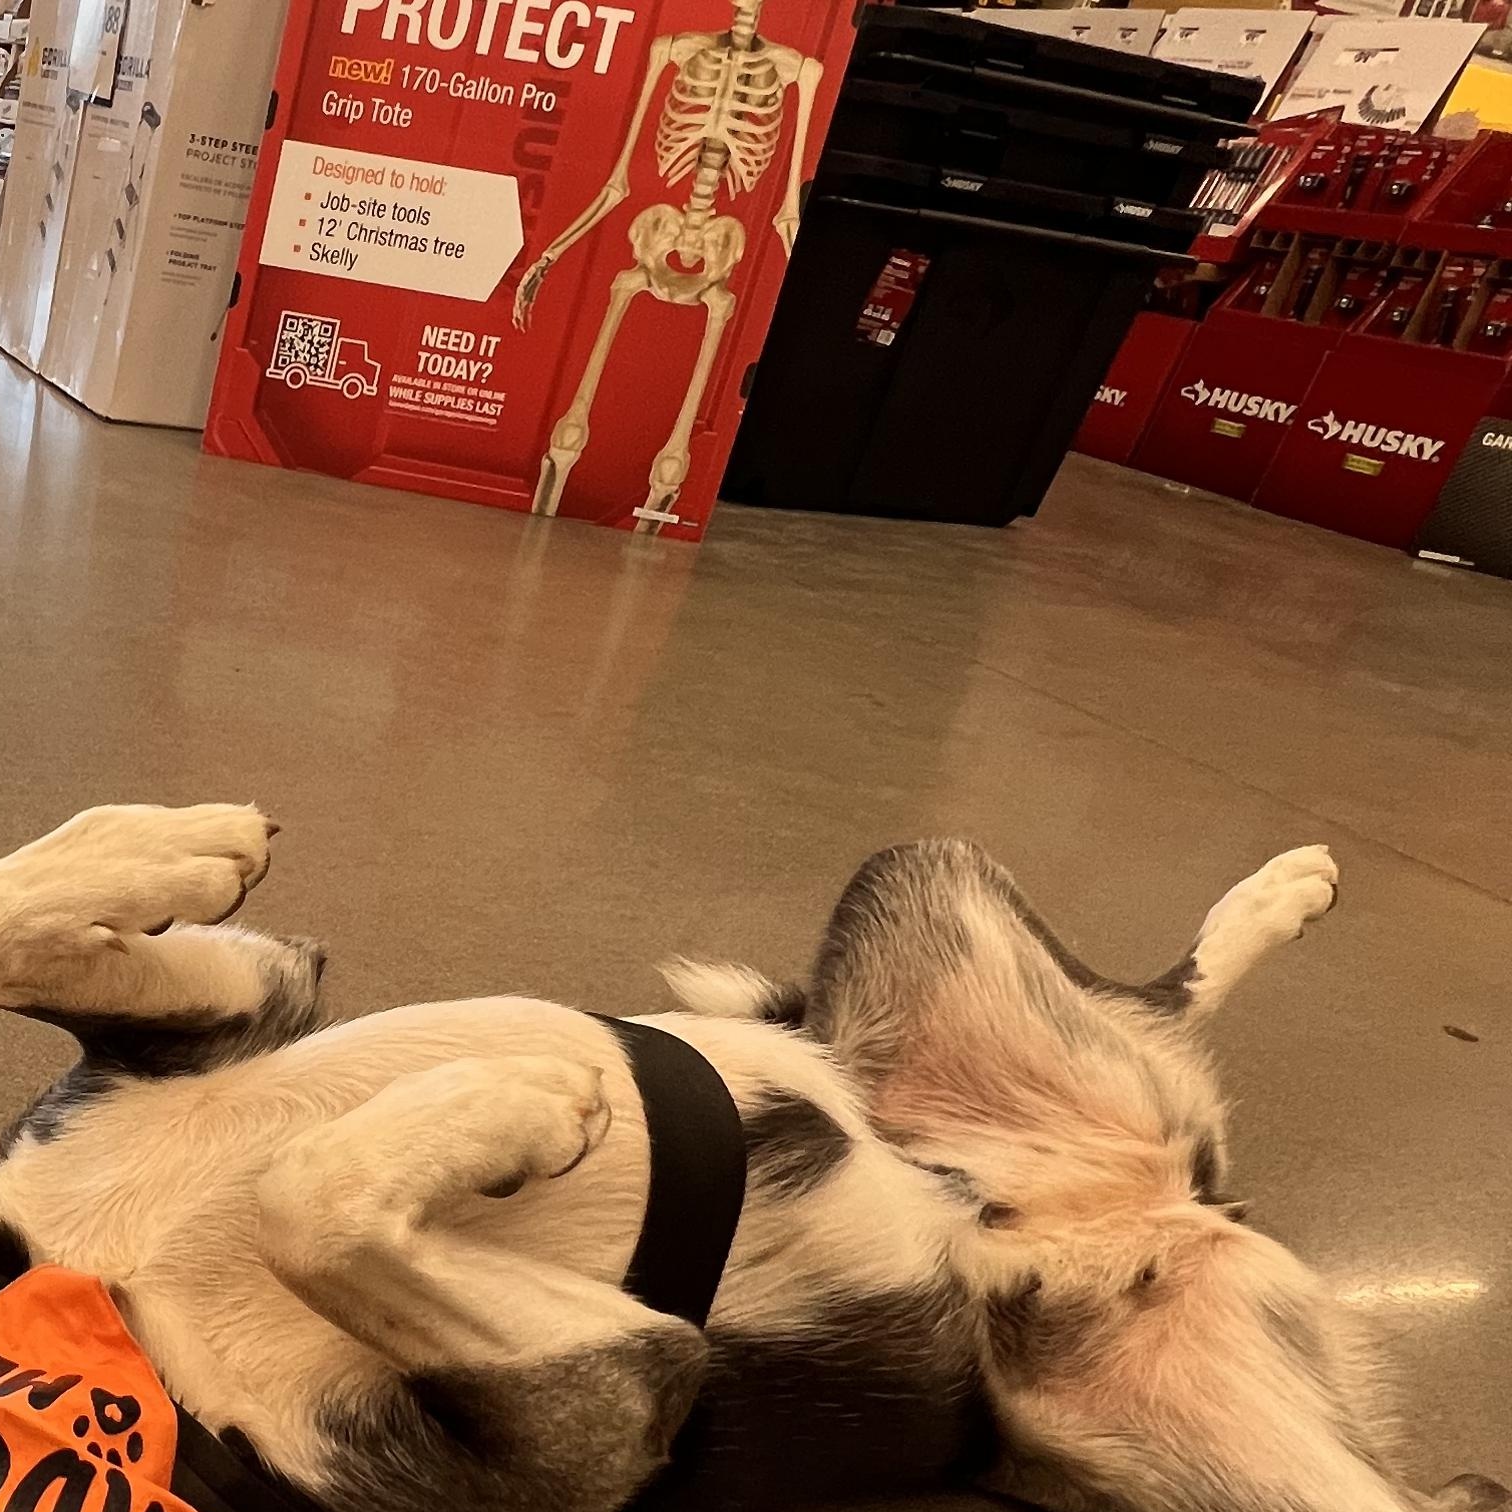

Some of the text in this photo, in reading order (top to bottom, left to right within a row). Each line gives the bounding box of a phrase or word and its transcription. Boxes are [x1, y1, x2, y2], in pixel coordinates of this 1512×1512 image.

[340, 0, 635, 74] PROTECT
[328, 55, 556, 112] new! 170-Gallon Pro
[322, 90, 413, 128] Grip Tote
[186, 148, 237, 167] PROJECT
[189, 133, 229, 151] 3-STEP
[312, 155, 448, 196] Designed to hold:
[320, 190, 431, 226] Job-site tools
[316, 216, 465, 259] 12' Christmas tree
[309, 242, 359, 272] Skelly
[421, 324, 502, 358] NEED IT
[416, 351, 493, 384] TODAY?
[389, 385, 423, 402] WHILE
[423, 391, 475, 412] SUPPLIES
[475, 400, 504, 416] LAST
[1207, 386, 1299, 424] HUSKY
[1339, 420, 1445, 462] HUSKY
